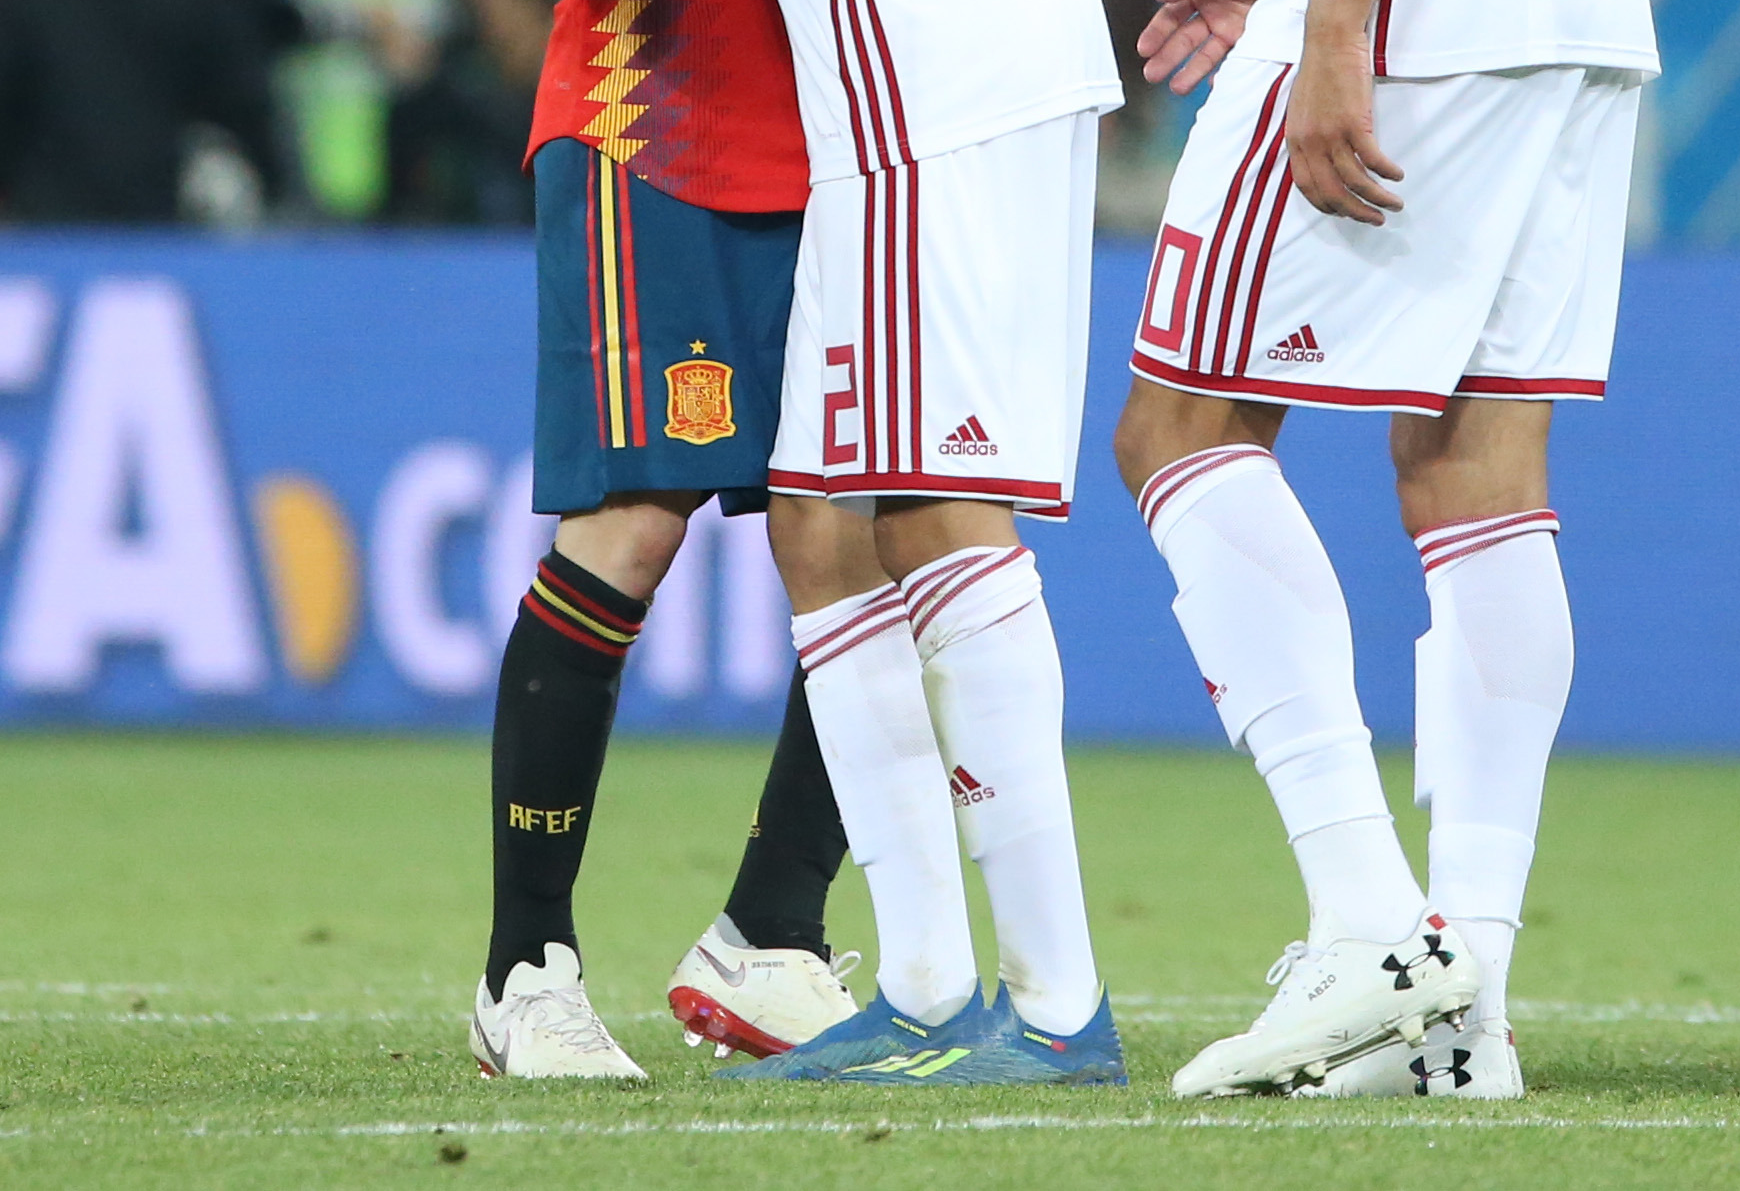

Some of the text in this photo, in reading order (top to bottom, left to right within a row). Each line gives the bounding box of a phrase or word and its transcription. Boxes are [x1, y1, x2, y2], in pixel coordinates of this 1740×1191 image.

[1266, 346, 1325, 364] adidas
[823, 344, 858, 466] 2
[938, 442, 999, 456] adidas
[1307, 974, 1337, 1001] AB20
